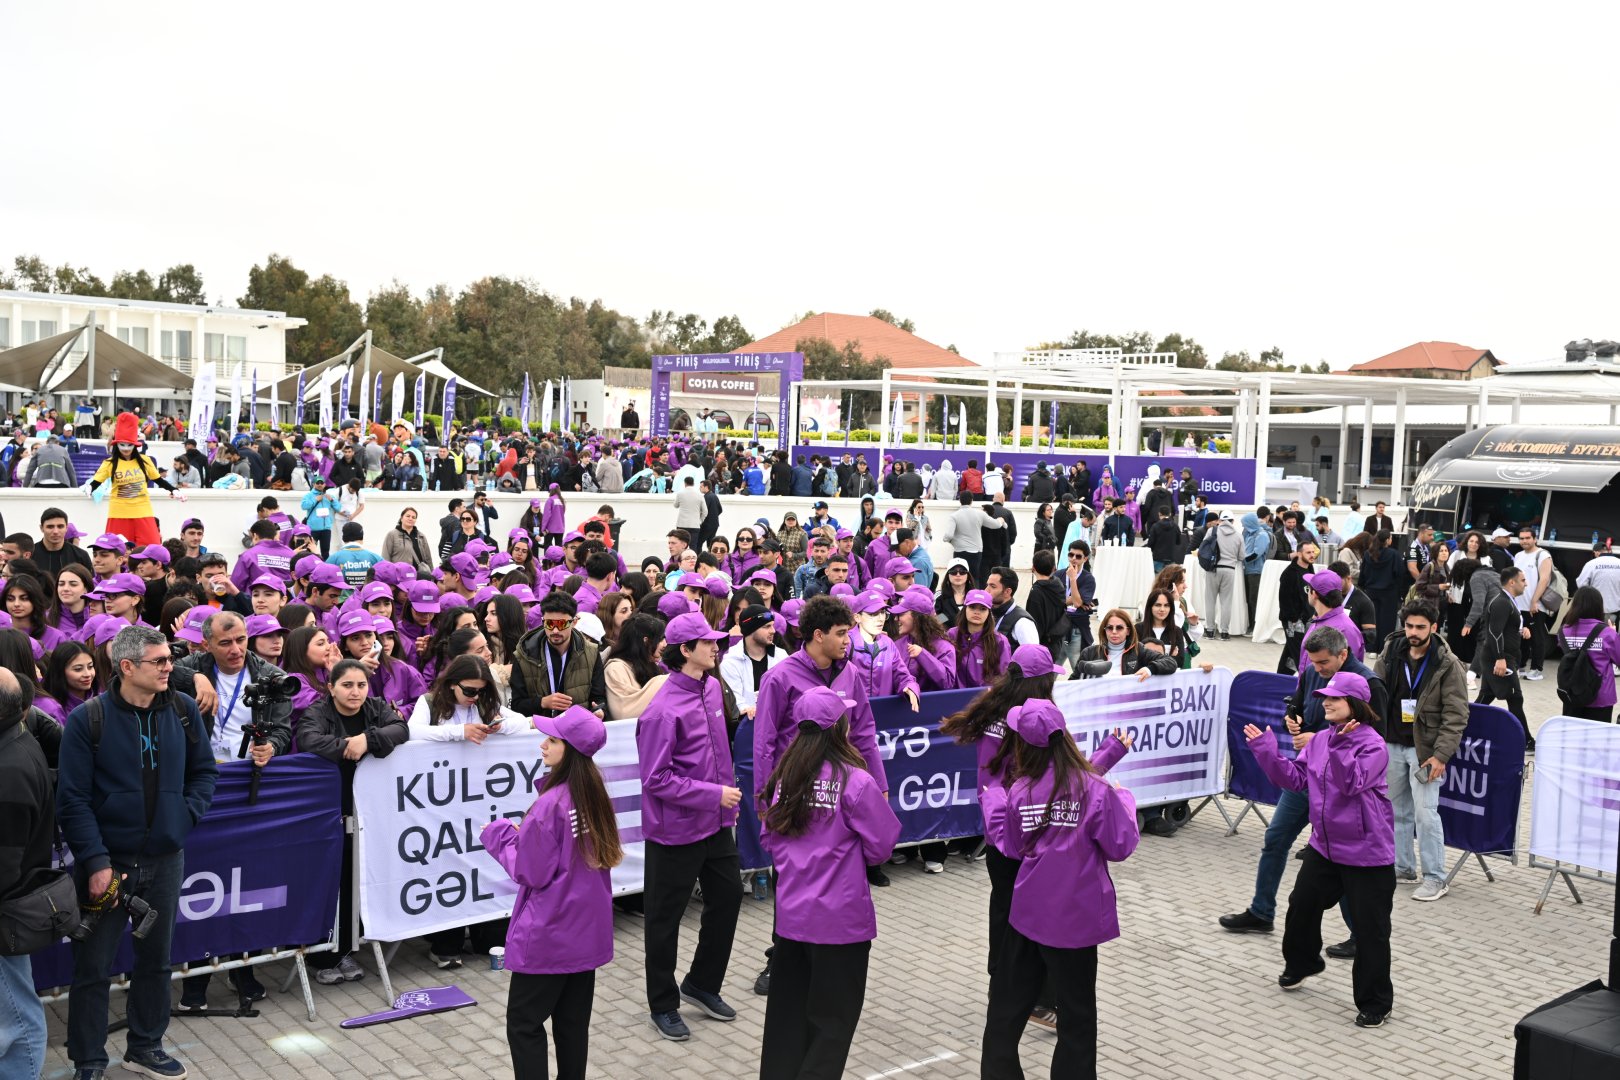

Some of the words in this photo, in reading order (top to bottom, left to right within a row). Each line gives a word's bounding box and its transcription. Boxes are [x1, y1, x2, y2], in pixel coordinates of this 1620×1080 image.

[676, 354, 699, 370] FİNİŞ
[734, 353, 760, 370] FİNİŞ
[688, 378, 719, 389] COSTA
[721, 379, 755, 391] COFFEE
[1494, 441, 1568, 455] НАСТОЯЩИЕ
[114, 468, 143, 480] BAK
[1170, 684, 1217, 714] BAKI
[1092, 717, 1214, 753] MRAFONU
[396, 758, 550, 812] KÜLƏY
[821, 780, 841, 792] BAKI
[898, 771, 971, 811] GƏL
[1060, 800, 1081, 811] BAKI
[178, 866, 263, 921] ƏL
[399, 867, 495, 915] GƏL
